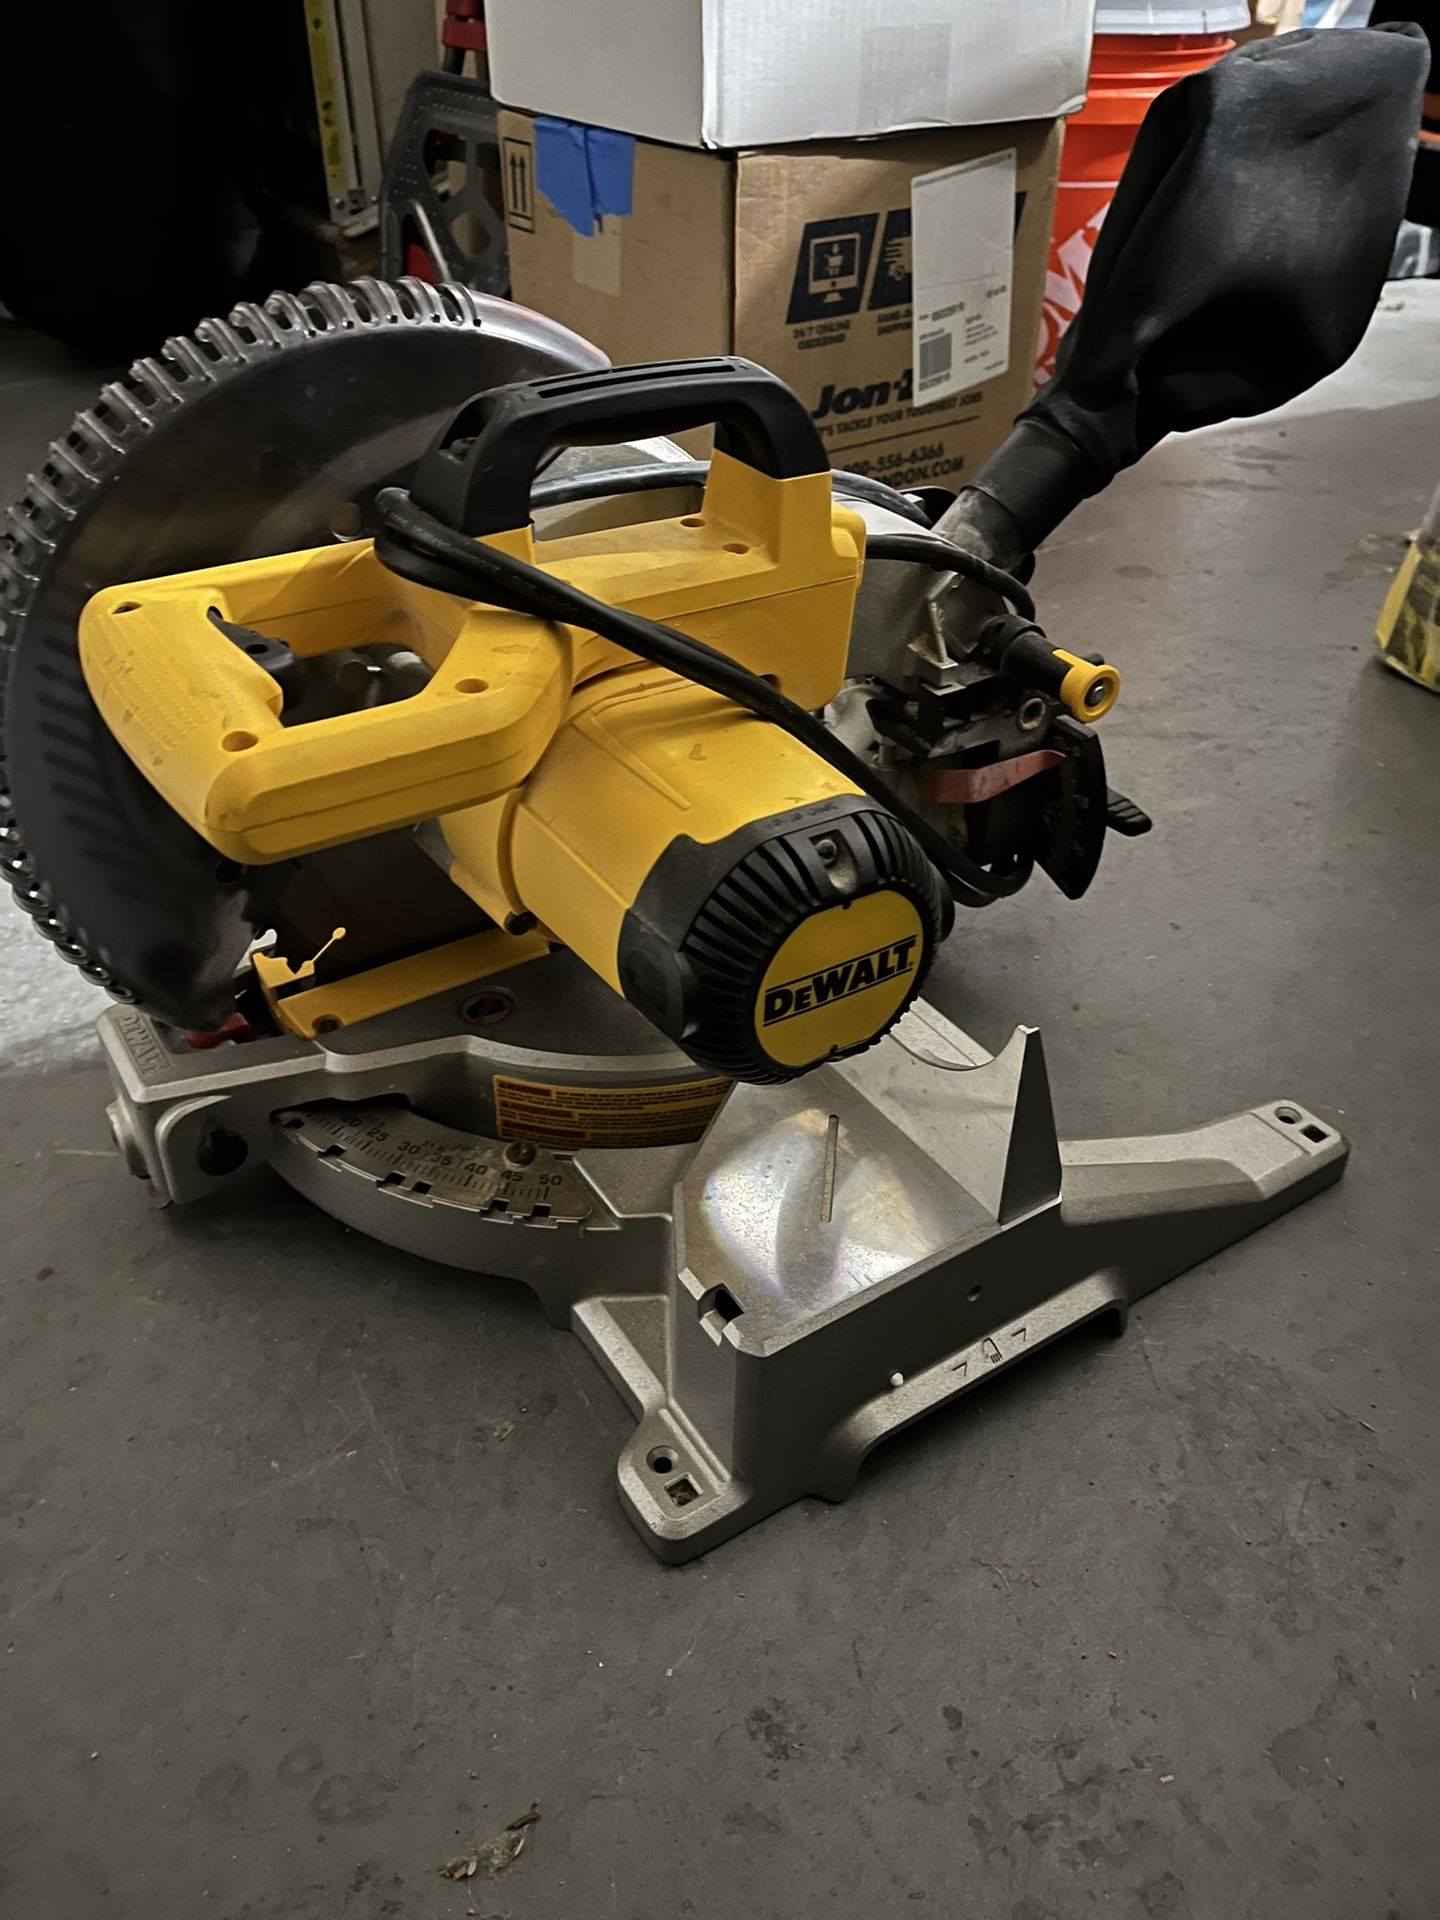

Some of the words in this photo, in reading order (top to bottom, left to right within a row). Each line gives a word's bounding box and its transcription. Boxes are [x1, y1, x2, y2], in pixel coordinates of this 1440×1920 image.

[837, 416, 873, 435] TACKLE
[875, 409, 903, 425] YOUR
[366, 1127, 390, 1142] 25
[398, 1140, 421, 1155] 30
[464, 1162, 488, 1175] 40
[501, 1170, 524, 1182] 45
[538, 1174, 562, 1186] 50
